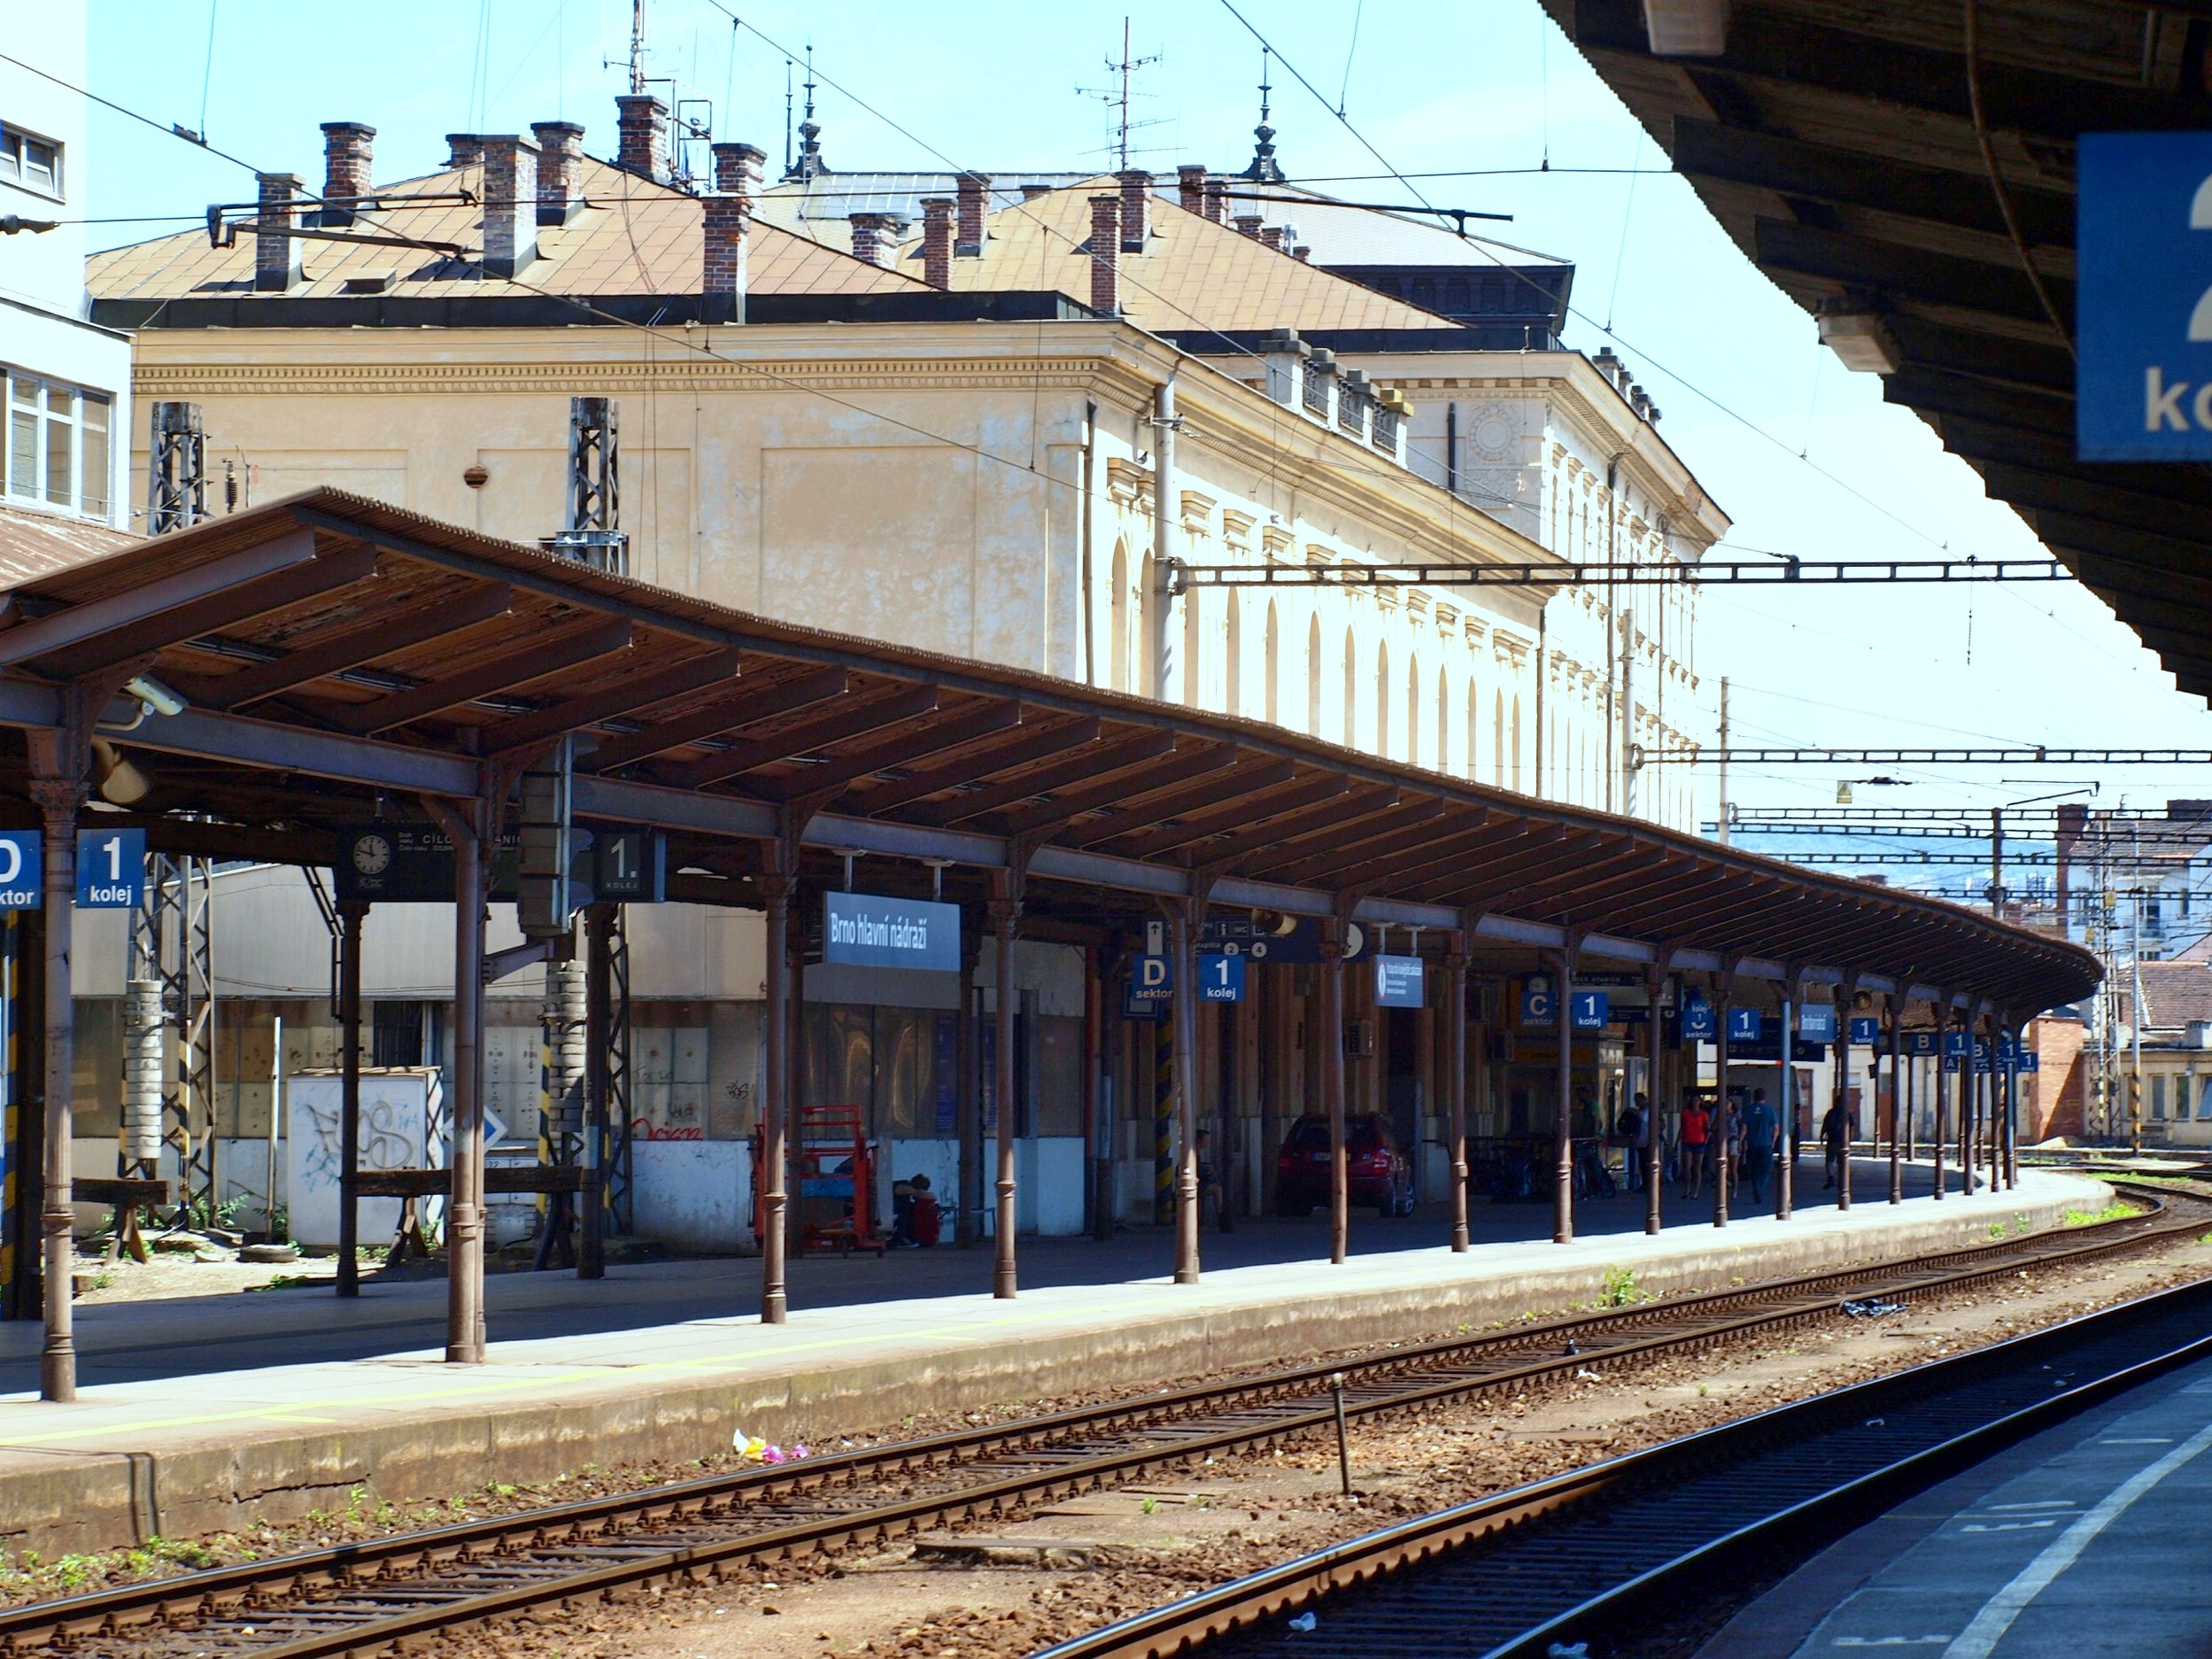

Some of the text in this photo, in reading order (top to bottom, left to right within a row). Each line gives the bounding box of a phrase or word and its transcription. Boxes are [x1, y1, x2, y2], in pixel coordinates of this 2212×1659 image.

[103, 836, 120, 880] 1
[611, 838, 637, 879] 1.
[90, 885, 132, 906] kolej
[831, 912, 927, 950] Brno hlavní nádraží
[1143, 959, 1166, 986] D
[1216, 959, 1228, 985] 1
[1135, 988, 1174, 999] sektor
[1207, 988, 1236, 1000] kolej
[1529, 995, 1549, 1016] C
[1584, 996, 1596, 1016] 1
[1578, 1017, 1602, 1027] kolej
[1739, 1012, 1748, 1030] 1
[1860, 1020, 1868, 1036] 1
[1734, 1030, 1754, 1040] kolej
[1918, 1035, 1930, 1049] B
[1955, 1035, 1963, 1049] 1
[2007, 1044, 2015, 1057] 1
[1946, 1058, 1955, 1068] A
[2025, 1054, 2032, 1066] 1
